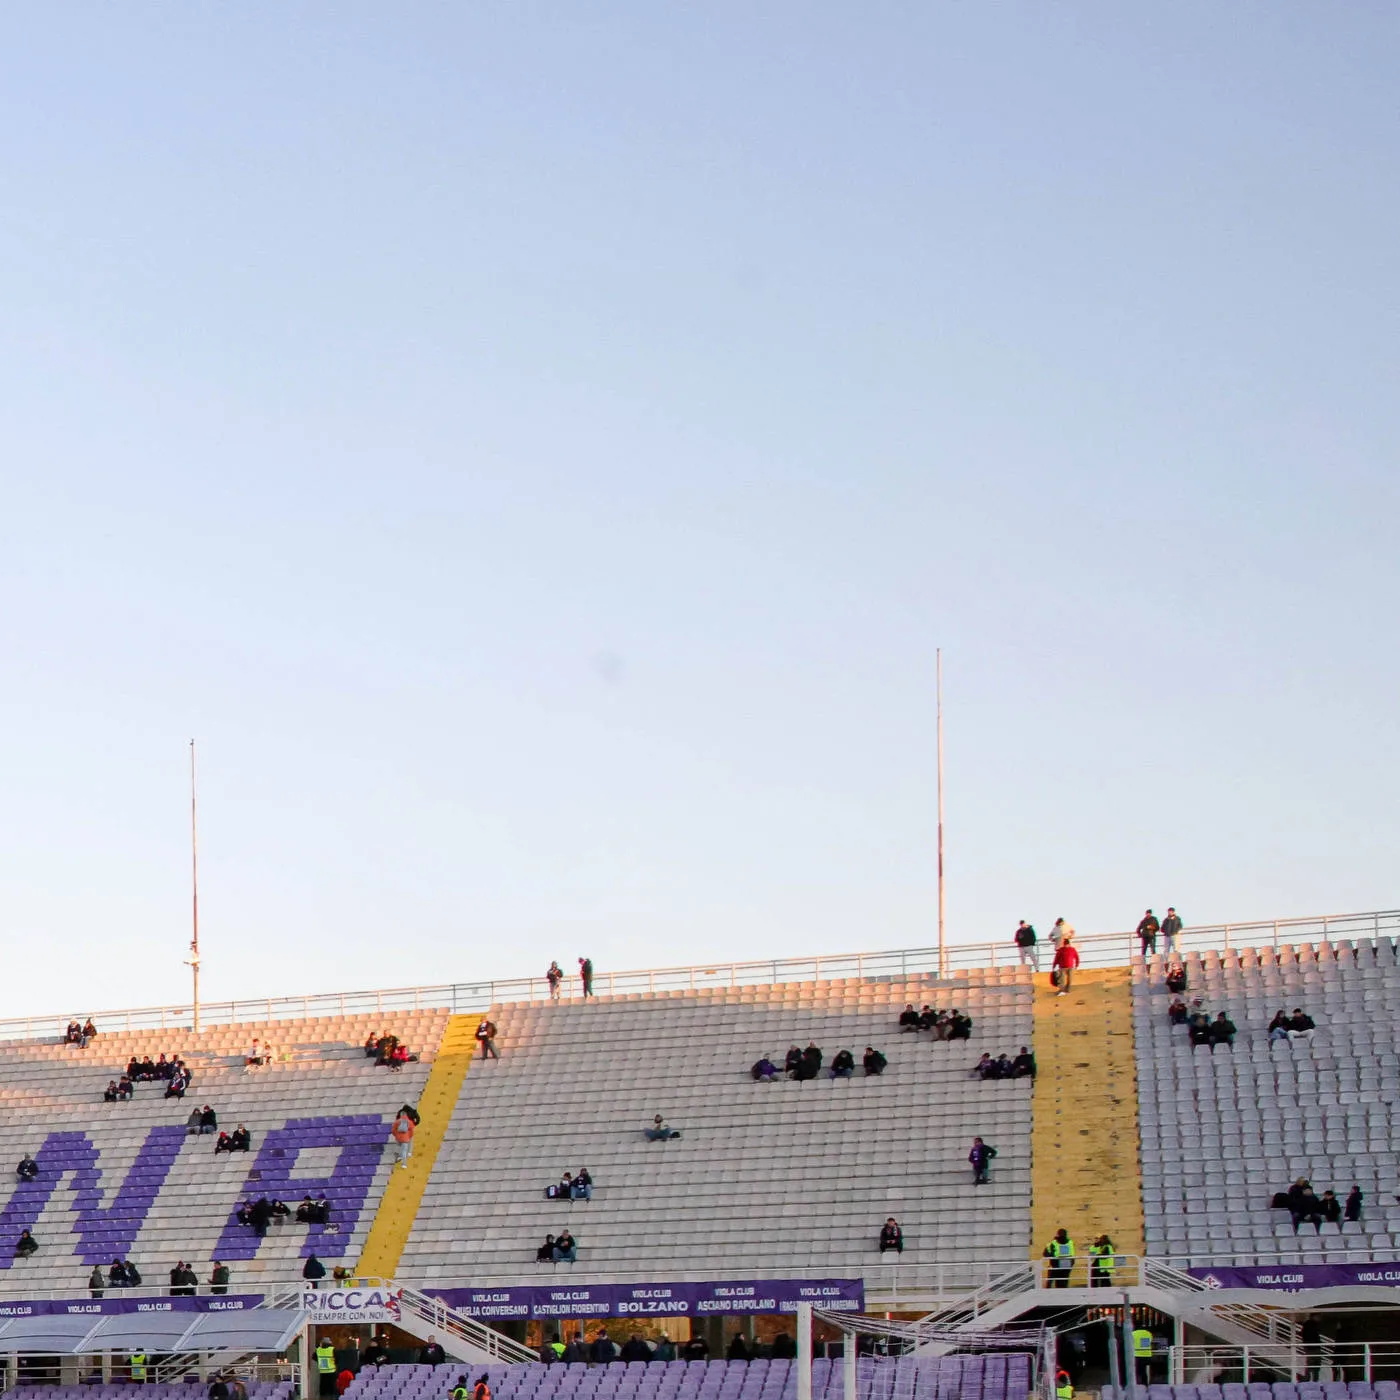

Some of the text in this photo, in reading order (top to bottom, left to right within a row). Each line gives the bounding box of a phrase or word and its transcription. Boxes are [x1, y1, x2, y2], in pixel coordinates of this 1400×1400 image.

[1257, 1274, 1304, 1284] VIOLA CLUB
[1358, 1272, 1383, 1281] VIOLA
[551, 1292, 590, 1300] VIOLA CLUB
[632, 1290, 672, 1298] VIOLA CLUB
[715, 1288, 755, 1296] VIOLA CLUB
[800, 1288, 840, 1296] VIOLA CLUB
[472, 1294, 510, 1302] VIOLA CLUB
[68, 1304, 102, 1313] VIOLA CLUB
[138, 1302, 172, 1311] VIOLA CLUB
[208, 1301, 244, 1310] VIOLA CLUB
[533, 1303, 610, 1314] CASTIGLION FIORENTINO
[618, 1301, 688, 1312] BOLZANO
[698, 1299, 776, 1310] ASCIANO RAPOLANO
[0, 1306, 32, 1315] VIOLA CLUB
[481, 1305, 528, 1316] CONVERSANO
[313, 1311, 384, 1320] SEMPRE CON NOI
